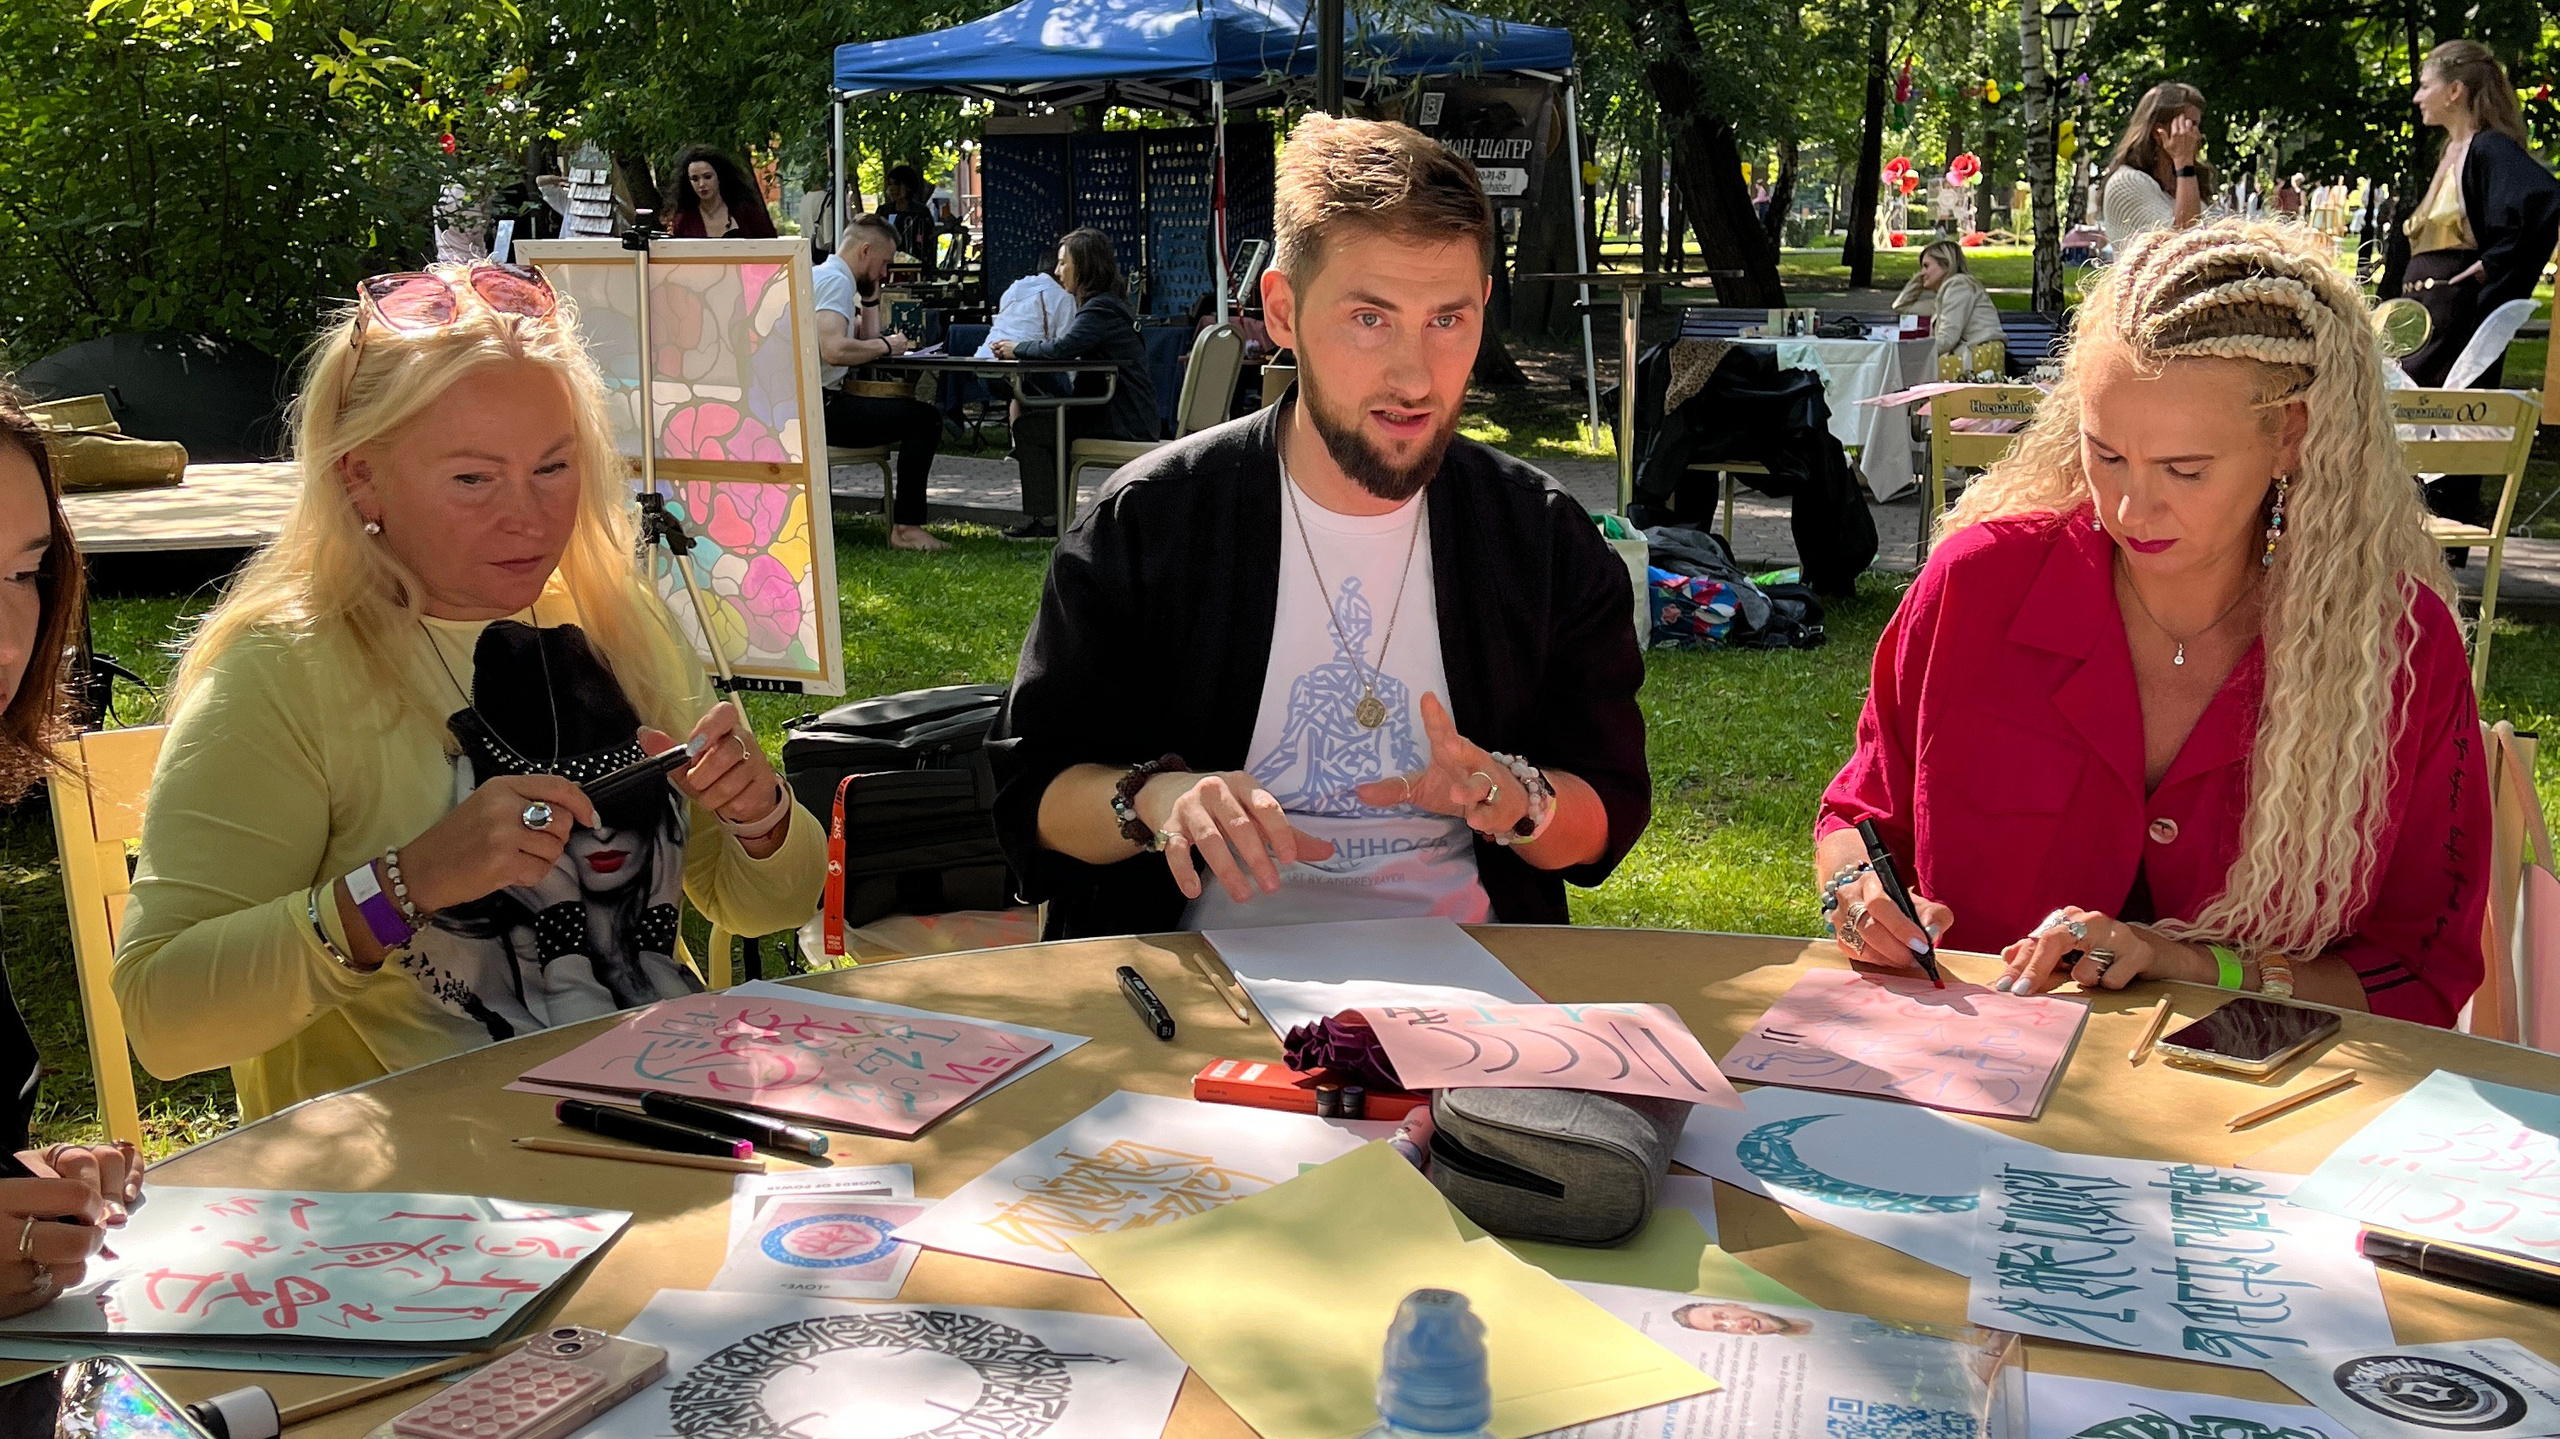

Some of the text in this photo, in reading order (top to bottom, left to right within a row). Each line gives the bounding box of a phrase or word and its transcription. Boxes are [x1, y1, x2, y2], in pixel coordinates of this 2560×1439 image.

[835, 1180, 882, 1188] WORDS
[2465, 1350, 2514, 1376] BETWEEN
[2510, 1375, 2538, 1390] LINE
